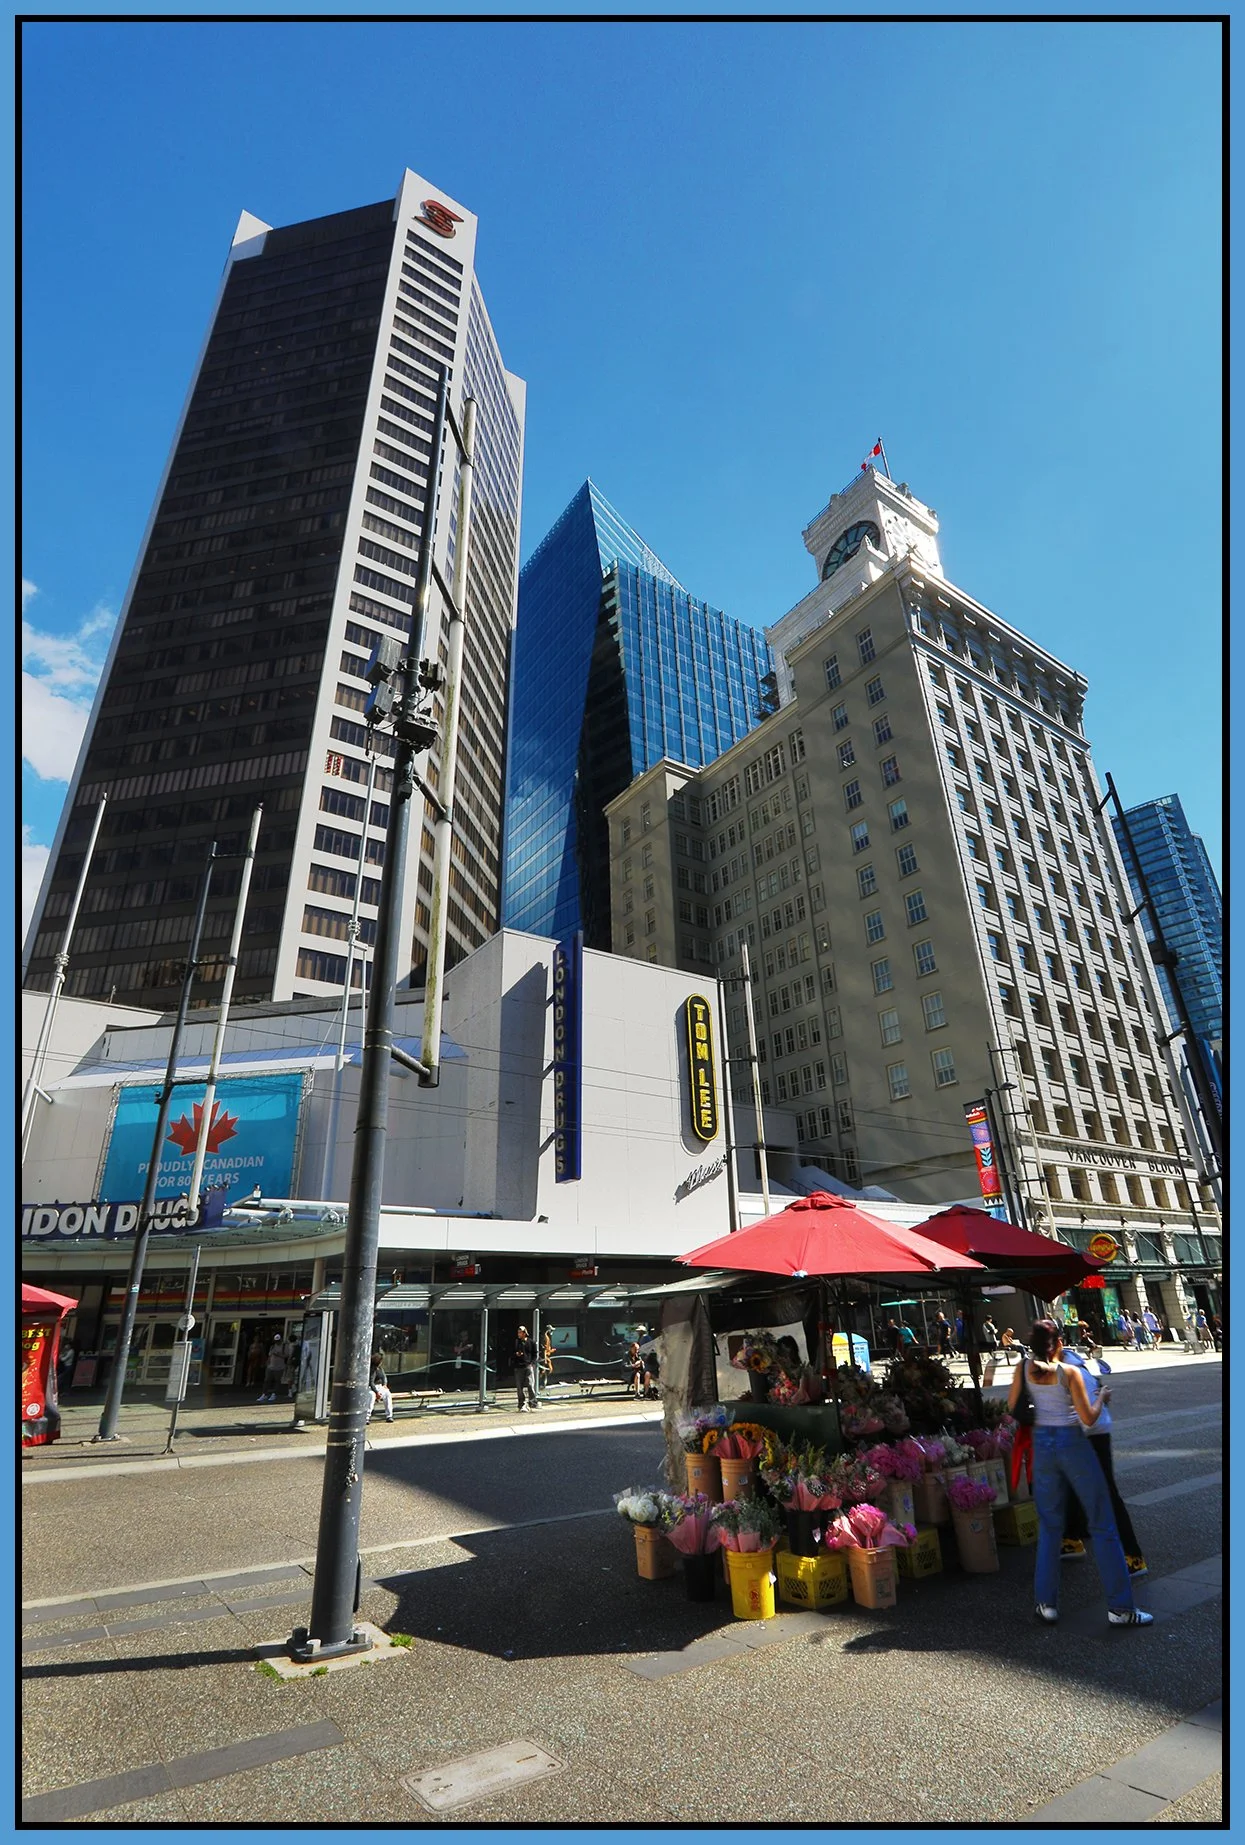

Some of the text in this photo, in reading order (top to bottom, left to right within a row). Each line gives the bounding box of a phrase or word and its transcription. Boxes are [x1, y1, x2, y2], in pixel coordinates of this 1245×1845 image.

[555, 949, 566, 1174] LONDON DRUGS
[693, 1003, 713, 1129] TOM LEE
[203, 1155, 265, 1171] CANADIAN
[1067, 1148, 1182, 1176] VANCOUVER BLOCK
[176, 1175, 191, 1187] 80
[200, 1172, 240, 1186] YEARS
[22, 1342, 40, 1351] og
